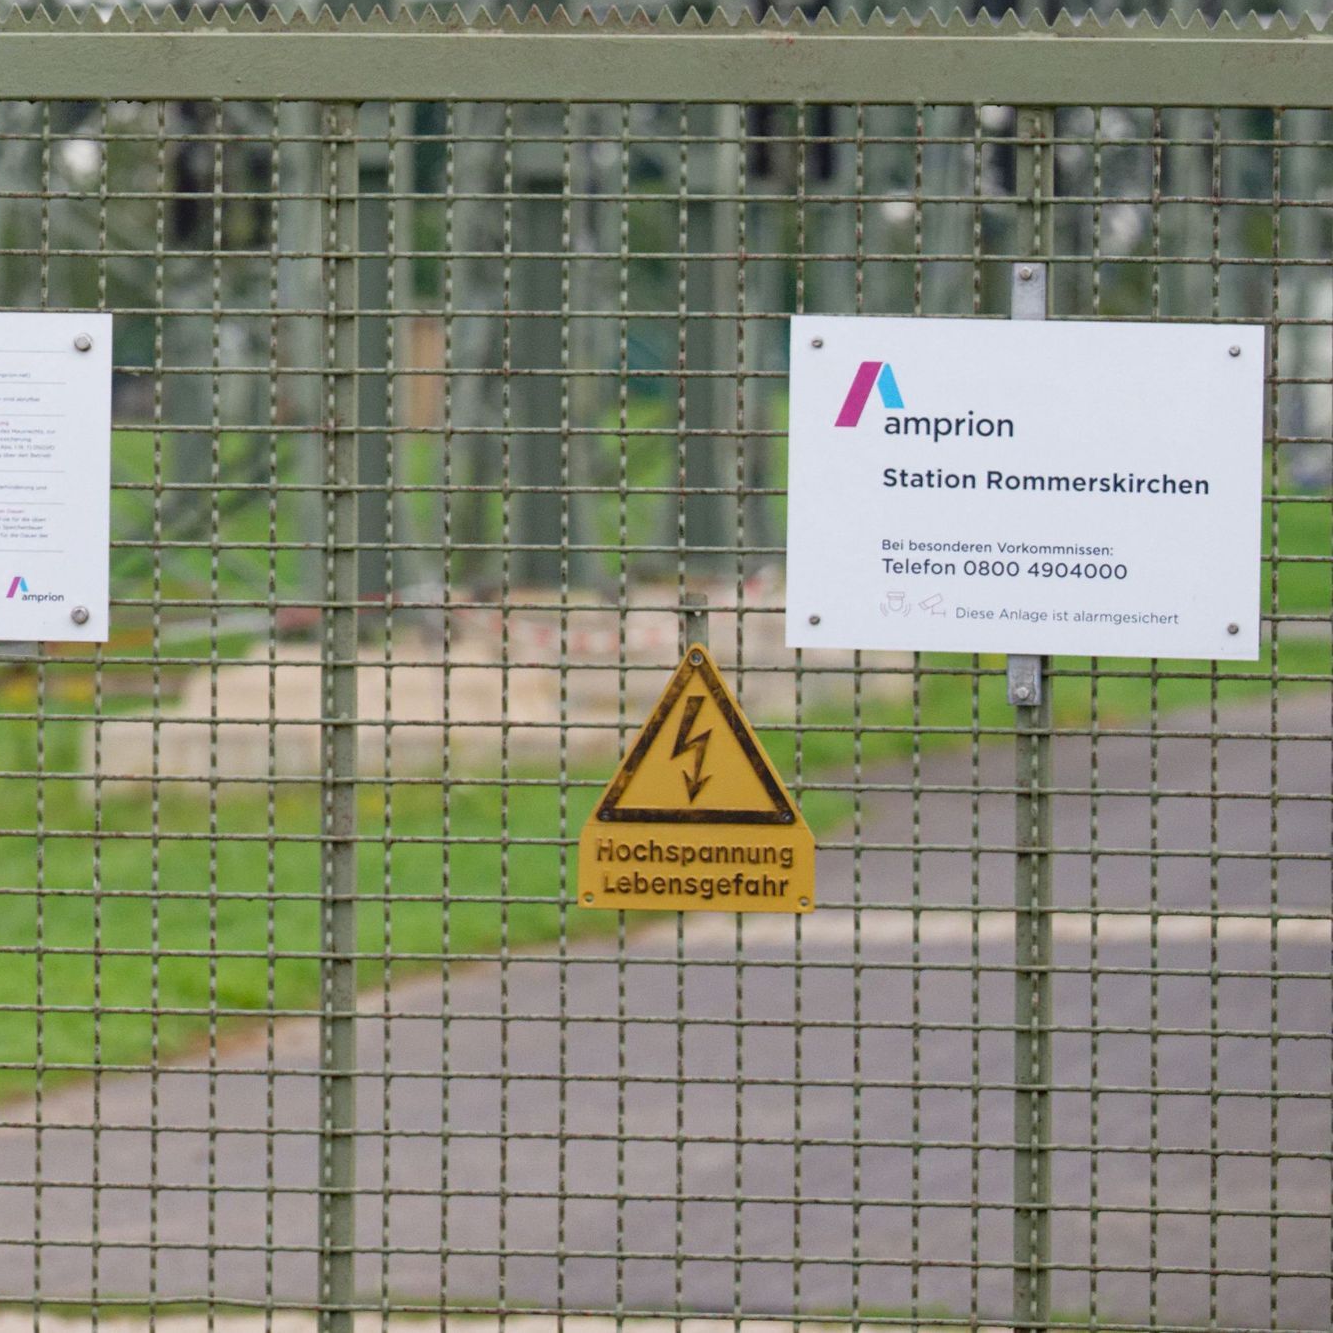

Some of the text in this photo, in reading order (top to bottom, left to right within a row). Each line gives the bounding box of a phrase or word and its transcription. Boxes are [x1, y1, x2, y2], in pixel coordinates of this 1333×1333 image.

[885, 411, 1013, 442] amprion
[883, 468, 1208, 494] Station Rommerskirchen
[882, 539, 1113, 556] Bei besonderen Vorkommnissen:
[882, 558, 1127, 579] Telefon 0800 4904000
[21, 590, 64, 602] amprion
[956, 607, 1178, 625] Diese Anlage ist alarmgesichert
[597, 839, 794, 868] Hochspannung
[604, 872, 789, 899] Lebensgefahr
